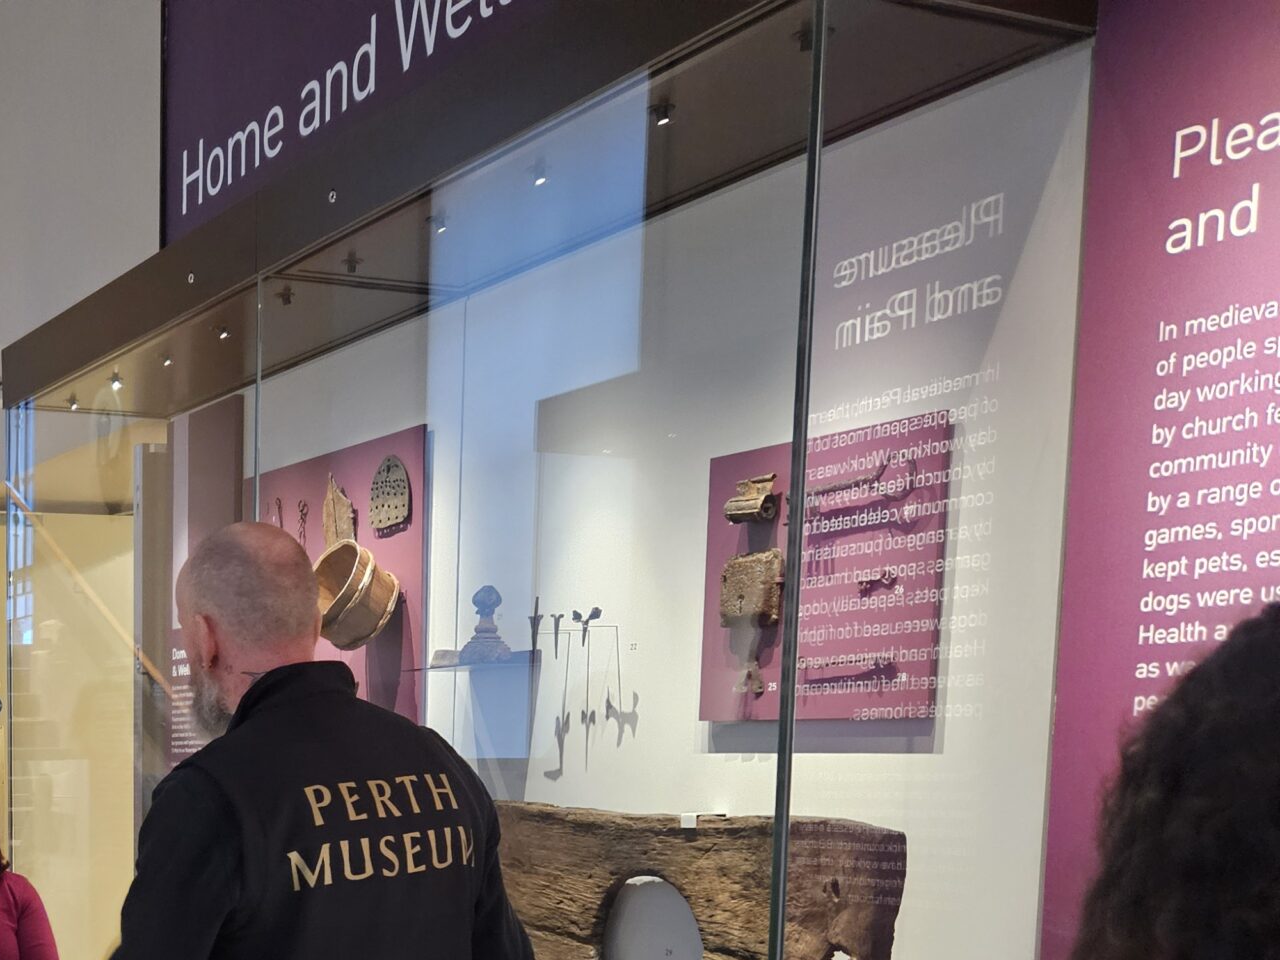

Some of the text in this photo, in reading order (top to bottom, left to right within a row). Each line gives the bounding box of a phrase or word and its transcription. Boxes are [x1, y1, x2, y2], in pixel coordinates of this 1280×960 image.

[182, 104, 284, 215] Home
[298, 14, 377, 137] and
[1165, 183, 1260, 254] and
[1159, 321, 1177, 342] In
[1155, 352, 1177, 376] of
[1182, 338, 1257, 376] people
[1153, 388, 1191, 412] day
[1151, 424, 1177, 448] by
[1182, 407, 1258, 439] church
[1149, 441, 1273, 478] community
[1147, 491, 1172, 515] by
[1176, 491, 1190, 508] a
[1196, 480, 1262, 507] range
[1144, 521, 1223, 551] games,
[1142, 556, 1189, 582] kept
[1194, 551, 1248, 579] pets,
[1140, 591, 1191, 616] dogs
[1196, 586, 1254, 608] were
[1138, 620, 1207, 645] Health
[1135, 662, 1160, 679] as
[768, 683, 777, 691] 25
[304, 773, 458, 827] PERTH
